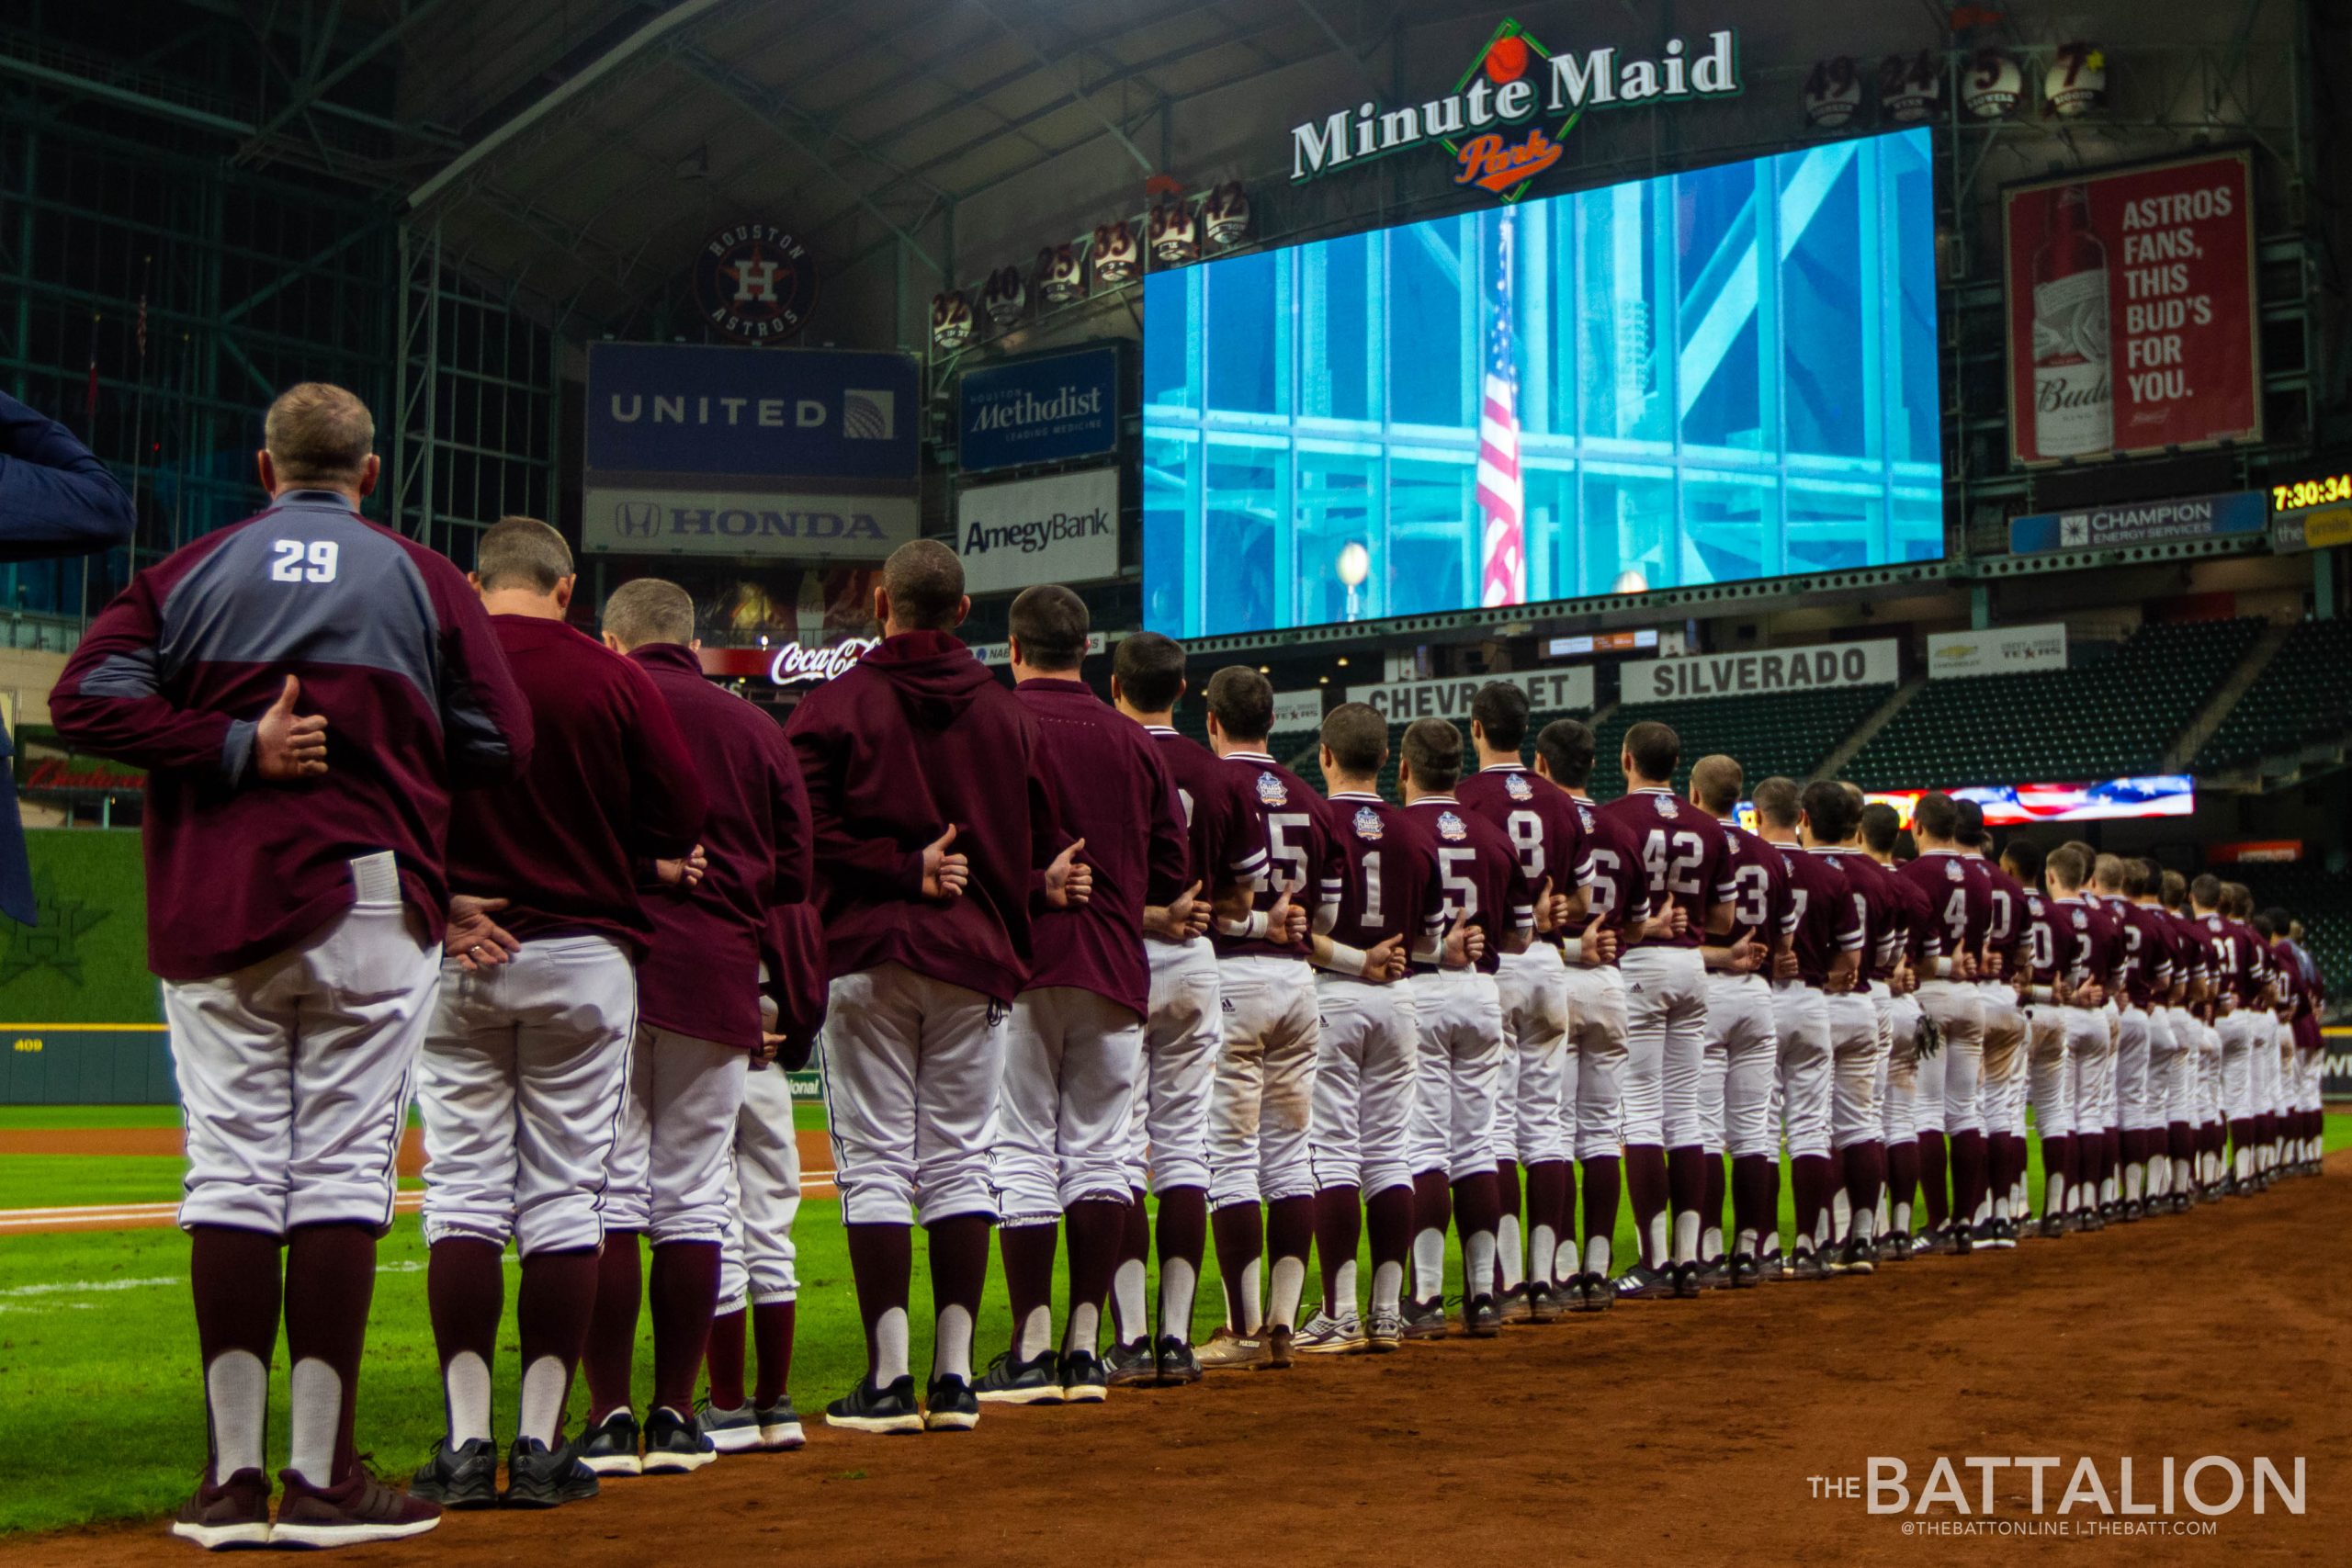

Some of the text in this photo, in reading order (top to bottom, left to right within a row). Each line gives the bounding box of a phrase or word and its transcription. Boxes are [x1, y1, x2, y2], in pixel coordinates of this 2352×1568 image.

[1290, 29, 1739, 179] Minute Maid
[1456, 128, 1560, 189] Park
[2122, 186, 2233, 232] ASTROS
[708, 224, 805, 260] HOUSTON
[2123, 228, 2204, 265] FANS,
[733, 260, 779, 301] H
[2124, 264, 2189, 300] THIS
[711, 308, 797, 337] ASTROS
[932, 290, 969, 326] 32
[2126, 295, 2212, 335] BUD'S
[2128, 334, 2184, 369] FOR
[970, 389, 1023, 405] HOUSTON
[2128, 368, 2194, 404] YOU.
[611, 393, 828, 428] UNITED
[970, 386, 1102, 434] Methodist
[1006, 419, 1102, 442] LEADING MEDICINE
[2273, 473, 2352, 512] 7:30:34
[670, 508, 888, 541] HONDA
[964, 508, 1110, 556] AmegyBank
[2092, 502, 2212, 532] CHAMPION
[2093, 522, 2212, 544] ENERGY SERVICES
[2278, 524, 2302, 544] the
[272, 539, 339, 583] 29
[772, 637, 882, 685] Coca-Co
[1653, 648, 1866, 697] SILVERADO
[1369, 674, 1569, 718] CHEVRET
[1507, 809, 1545, 879] 8
[1642, 829, 1702, 894] 42
[1360, 850, 1385, 928] 1
[1438, 847, 1477, 920] 5
[1587, 848, 1620, 916] 6
[1735, 865, 1769, 925] 3
[1943, 888, 1968, 939] 4
